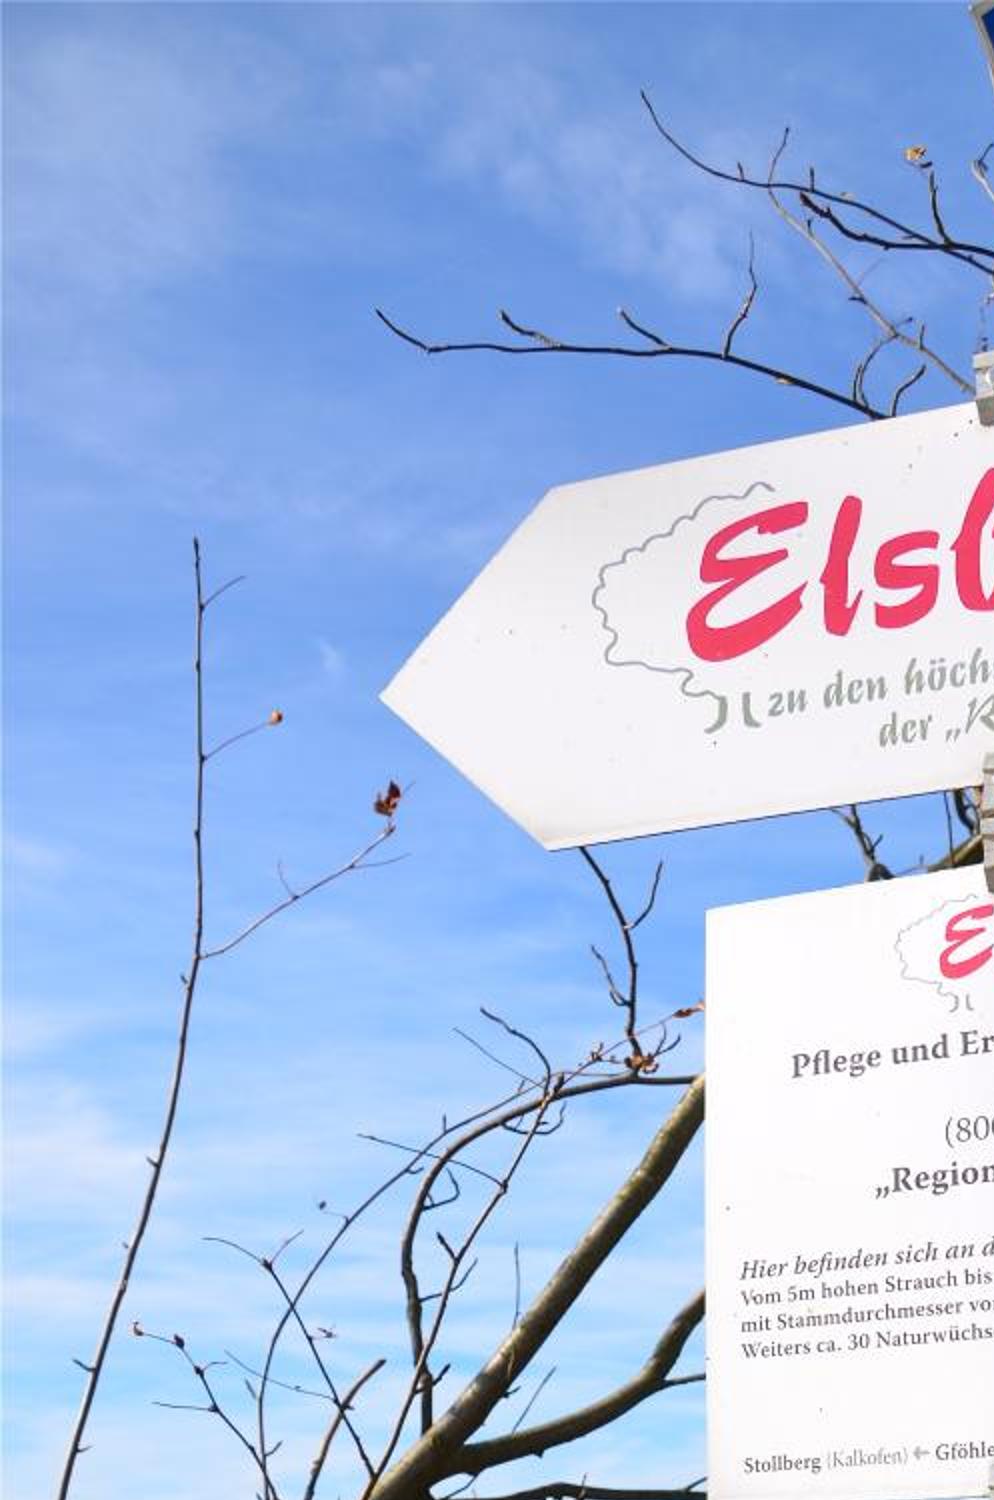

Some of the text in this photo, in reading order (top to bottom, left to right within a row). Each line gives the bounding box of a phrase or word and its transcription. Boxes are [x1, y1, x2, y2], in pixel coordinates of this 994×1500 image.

[767, 691, 808, 717] zu
[823, 669, 887, 709] den
[879, 713, 932, 747] der
[791, 1049, 882, 1078] Pflege
[892, 1033, 950, 1064] und
[739, 1258, 789, 1281] Hier
[793, 1248, 889, 1278] befinden
[895, 1240, 939, 1266] sich
[945, 1241, 976, 1260] an
[741, 1287, 782, 1308] Vom
[786, 1285, 815, 1304] 5m
[820, 1279, 879, 1300] hohen
[885, 1270, 958, 1295] Strauch
[964, 1267, 994, 1287] bis
[741, 1315, 773, 1334] mit
[776, 1299, 964, 1331] Stammdurchmesser
[741, 1338, 812, 1360] Weiters
[816, 1336, 844, 1354] ca.
[847, 1332, 872, 1352] 30
[743, 1453, 823, 1475] Stollberg
[826, 1447, 910, 1470] (Kalkofen)
